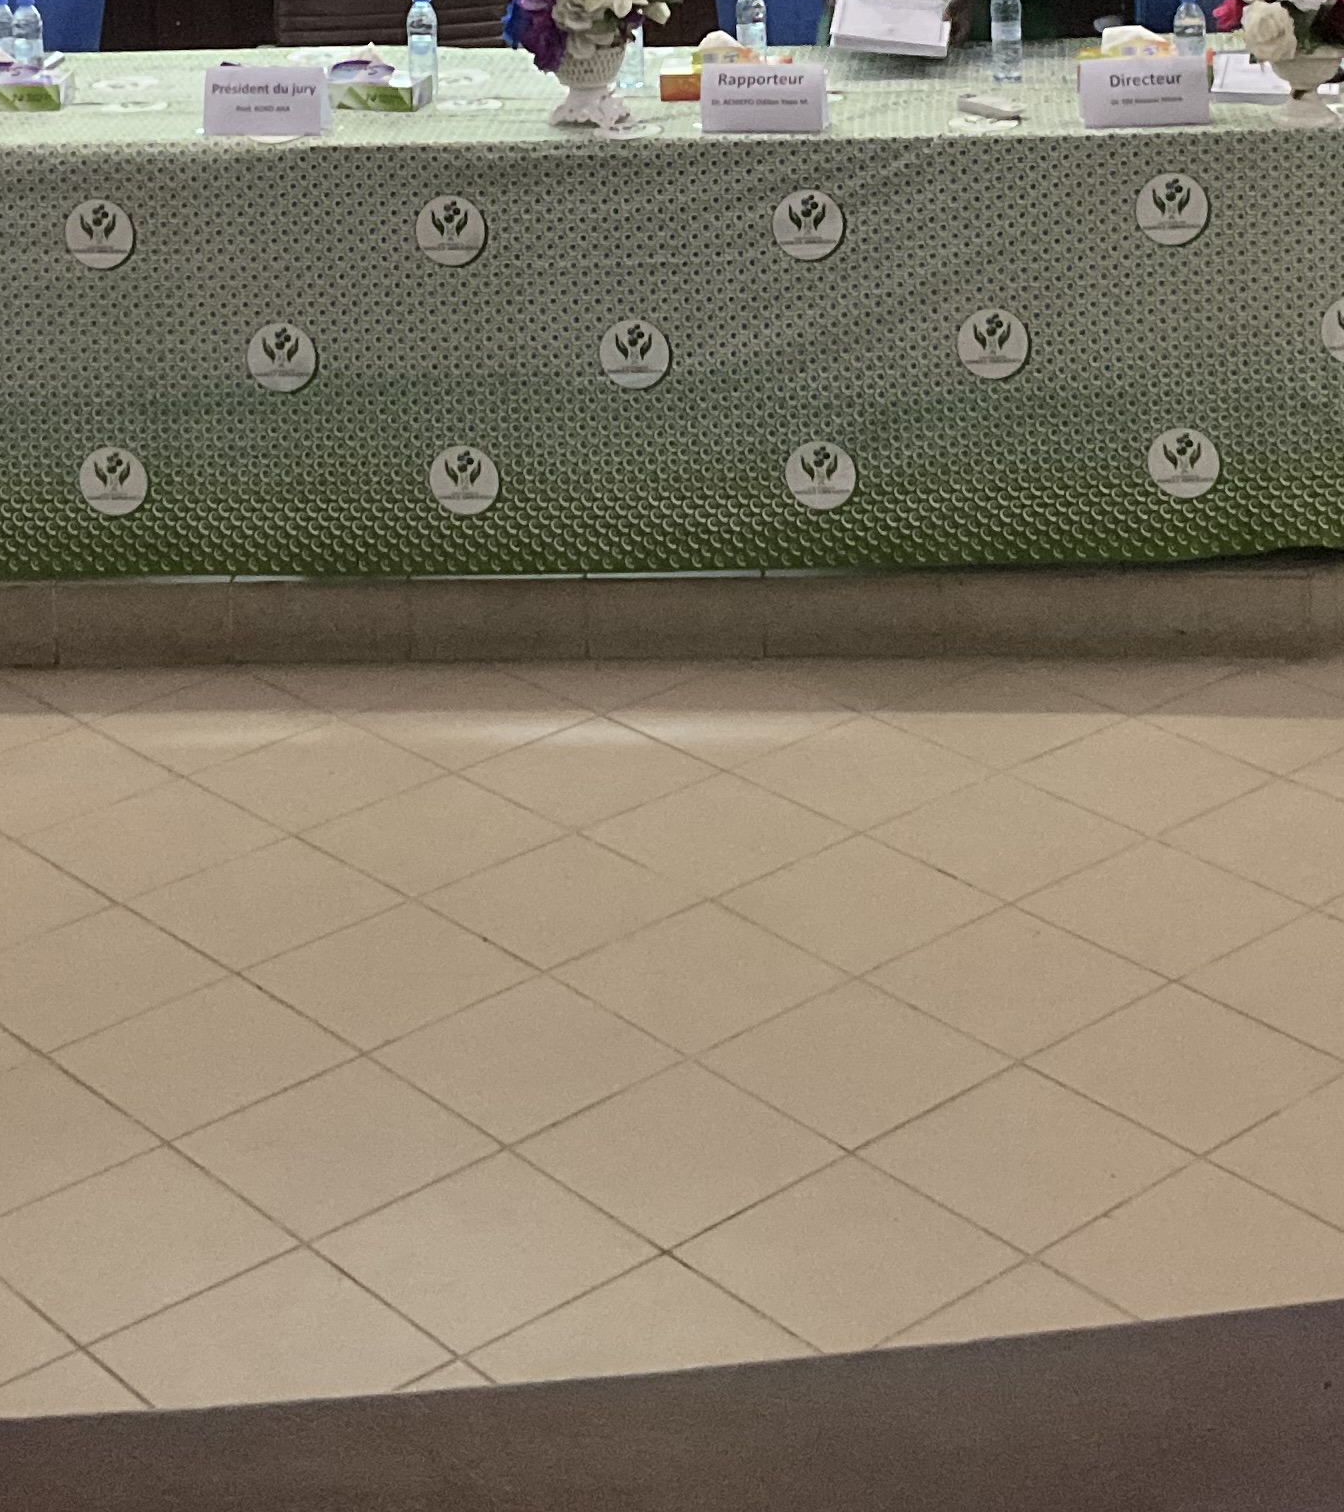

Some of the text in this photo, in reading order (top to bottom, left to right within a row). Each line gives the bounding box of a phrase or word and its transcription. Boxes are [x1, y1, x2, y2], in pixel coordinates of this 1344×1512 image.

[718, 72, 804, 88] Rapporteur
[1109, 73, 1182, 88] Directeur
[212, 83, 316, 97] Président du jury
